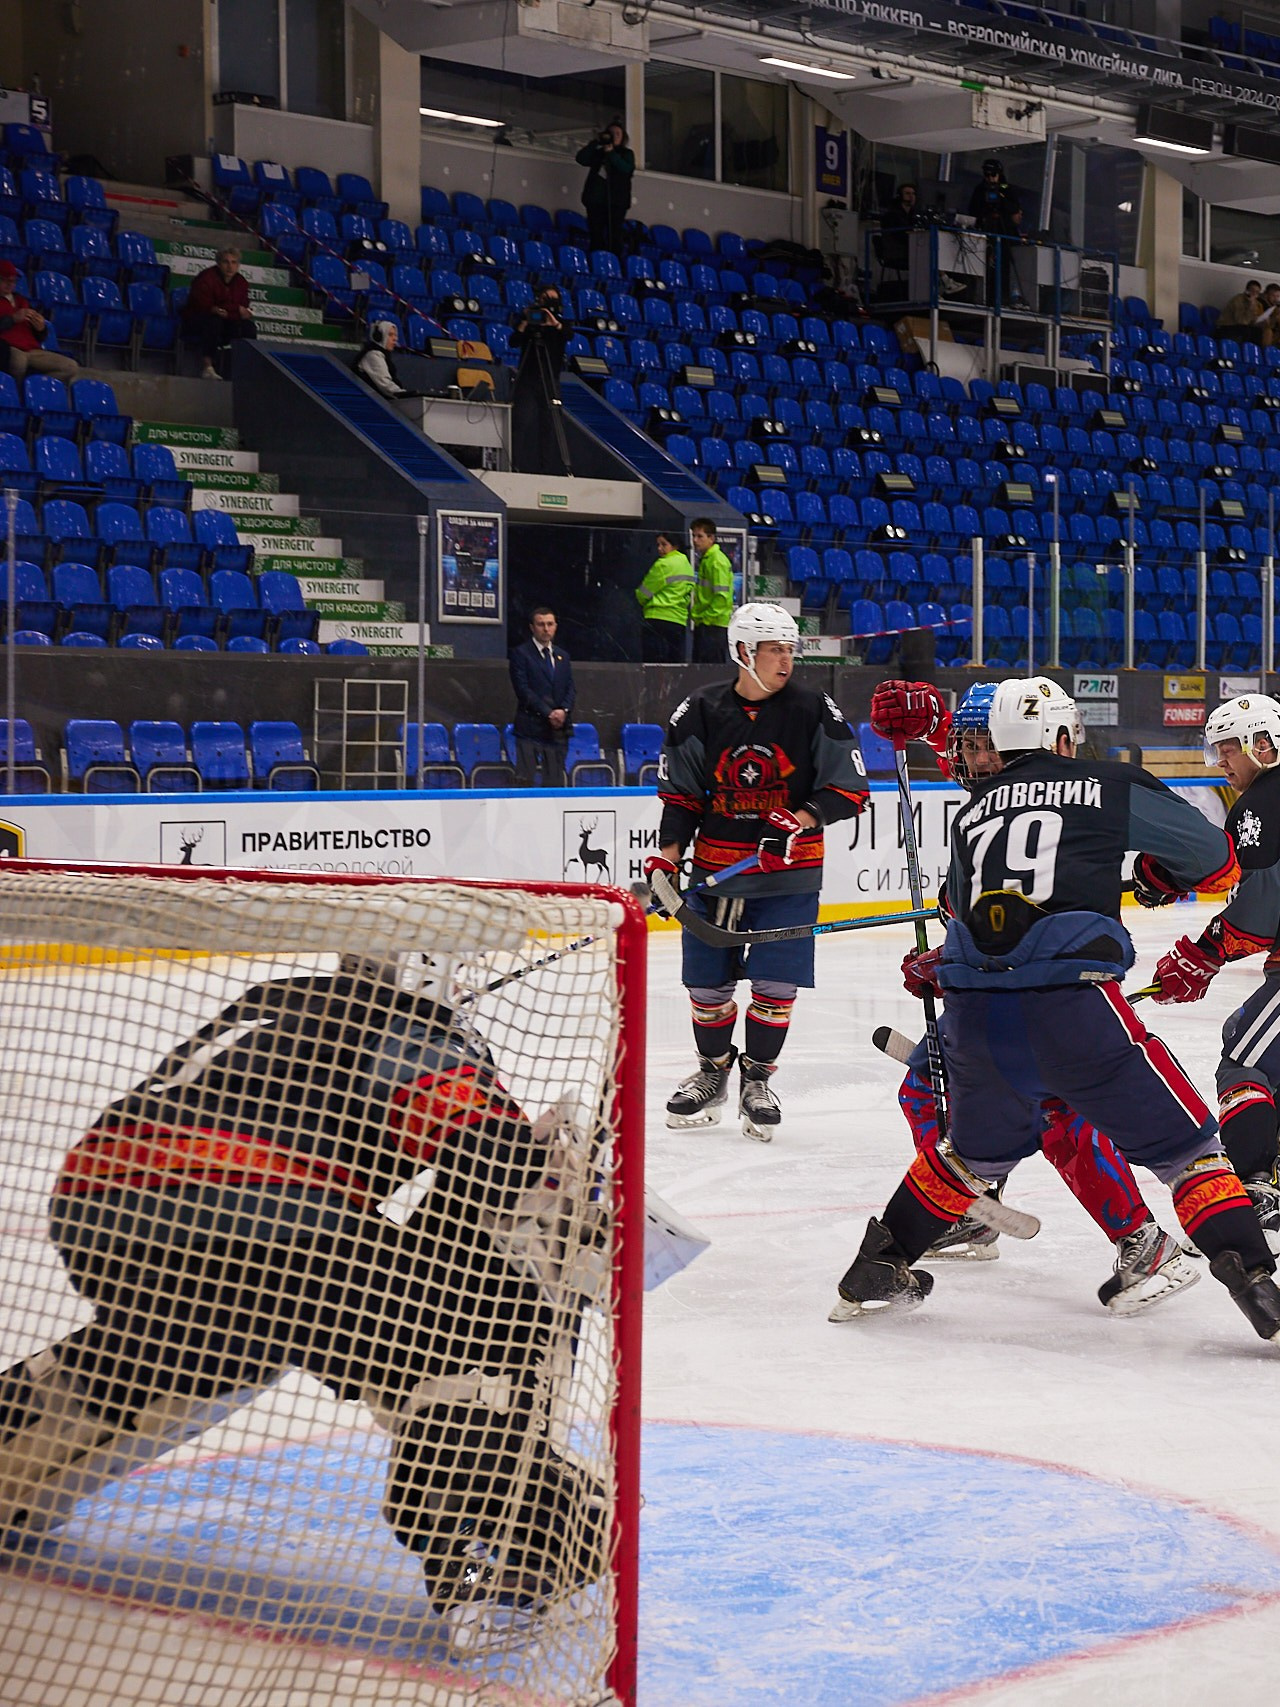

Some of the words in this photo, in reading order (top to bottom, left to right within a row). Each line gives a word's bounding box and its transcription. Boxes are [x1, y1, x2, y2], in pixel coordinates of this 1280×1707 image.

[861, 1, 923, 27] ХОККЕЮ
[948, 20, 1066, 59] ВСЕРОССИЙСКАЯ
[1070, 48, 1149, 79] ХОККЕЙНАЯ
[32, 100, 47, 120] 5
[825, 140, 839, 171] 9
[148, 429, 168, 440] ДЛЯ
[169, 430, 213, 443] ЧИСТОТЫ
[180, 452, 234, 467] SYNERGETIC
[187, 473, 206, 483] ДЛЯ
[207, 474, 250, 485] КРАСОТЫ
[219, 495, 274, 511] SYNERGETIC
[242, 517, 291, 529] ЗДОРОВЬЯ
[262, 538, 315, 551] SYNERGETIC
[272, 559, 293, 570] ДЛЯ
[294, 560, 336, 571] ЧИСТОТЫ
[307, 581, 360, 595] SYNERGETIC
[315, 602, 335, 612] ДЛЯ
[336, 603, 378, 614] КРАСОТЫ
[351, 626, 403, 639] SYNERGETIC
[1078, 680, 1115, 693] PARI
[1023, 699, 1039, 715] Z
[1163, 709, 1204, 721] FONBET
[851, 749, 866, 777] 8
[768, 811, 799, 830] CCM
[848, 800, 961, 850] ЛИГ
[241, 828, 431, 853] ПРАВИТЕЛЬСТВО
[966, 810, 1063, 911] 79
[857, 867, 950, 893] СИЛЬН
[1169, 948, 1215, 980] CCM
[926, 1020, 944, 1111] BAUER
